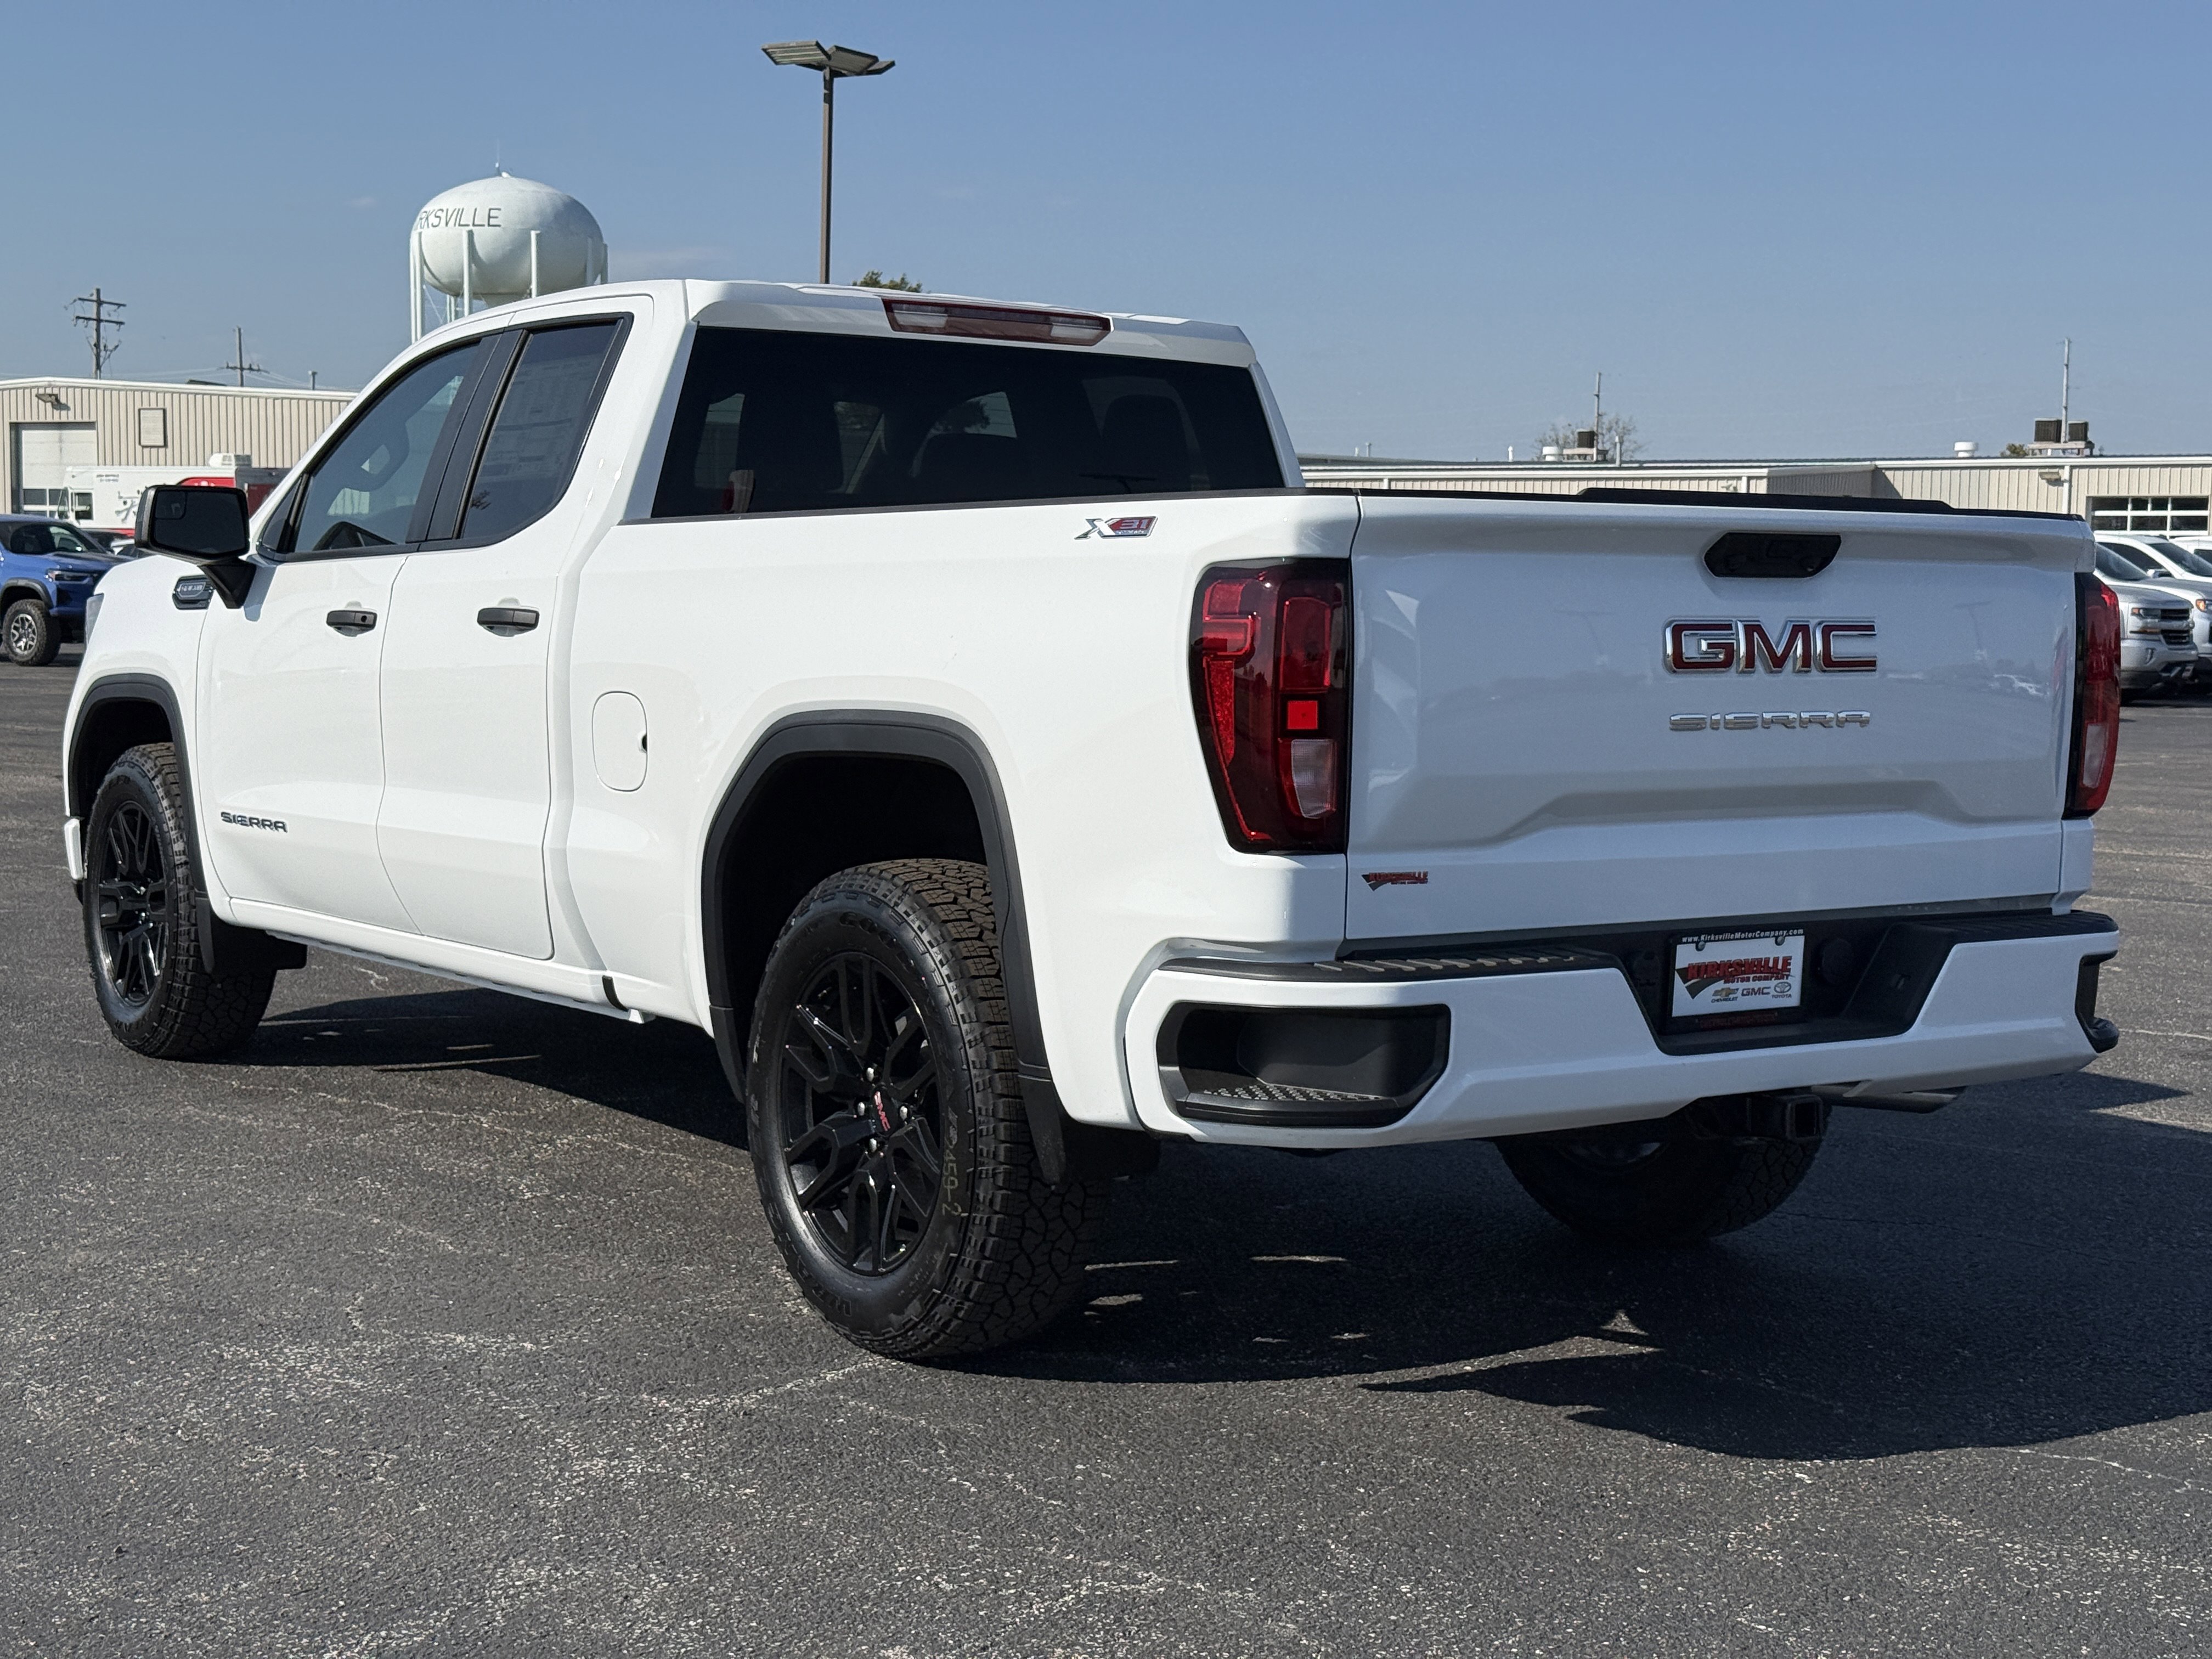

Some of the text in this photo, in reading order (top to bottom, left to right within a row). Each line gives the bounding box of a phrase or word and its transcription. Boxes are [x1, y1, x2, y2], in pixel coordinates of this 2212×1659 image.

[1663, 618, 1877, 674] GMC
[1669, 710, 1871, 731] SIERRA
[221, 811, 288, 833] SIERRA
[1681, 929, 1804, 943] www.KirksvilleMotorCompany.com
[1688, 956, 1792, 980] KIRKSVILLE
[1724, 973, 1791, 984] MOTOR COMPANY
[1741, 986, 1771, 997] GMC
